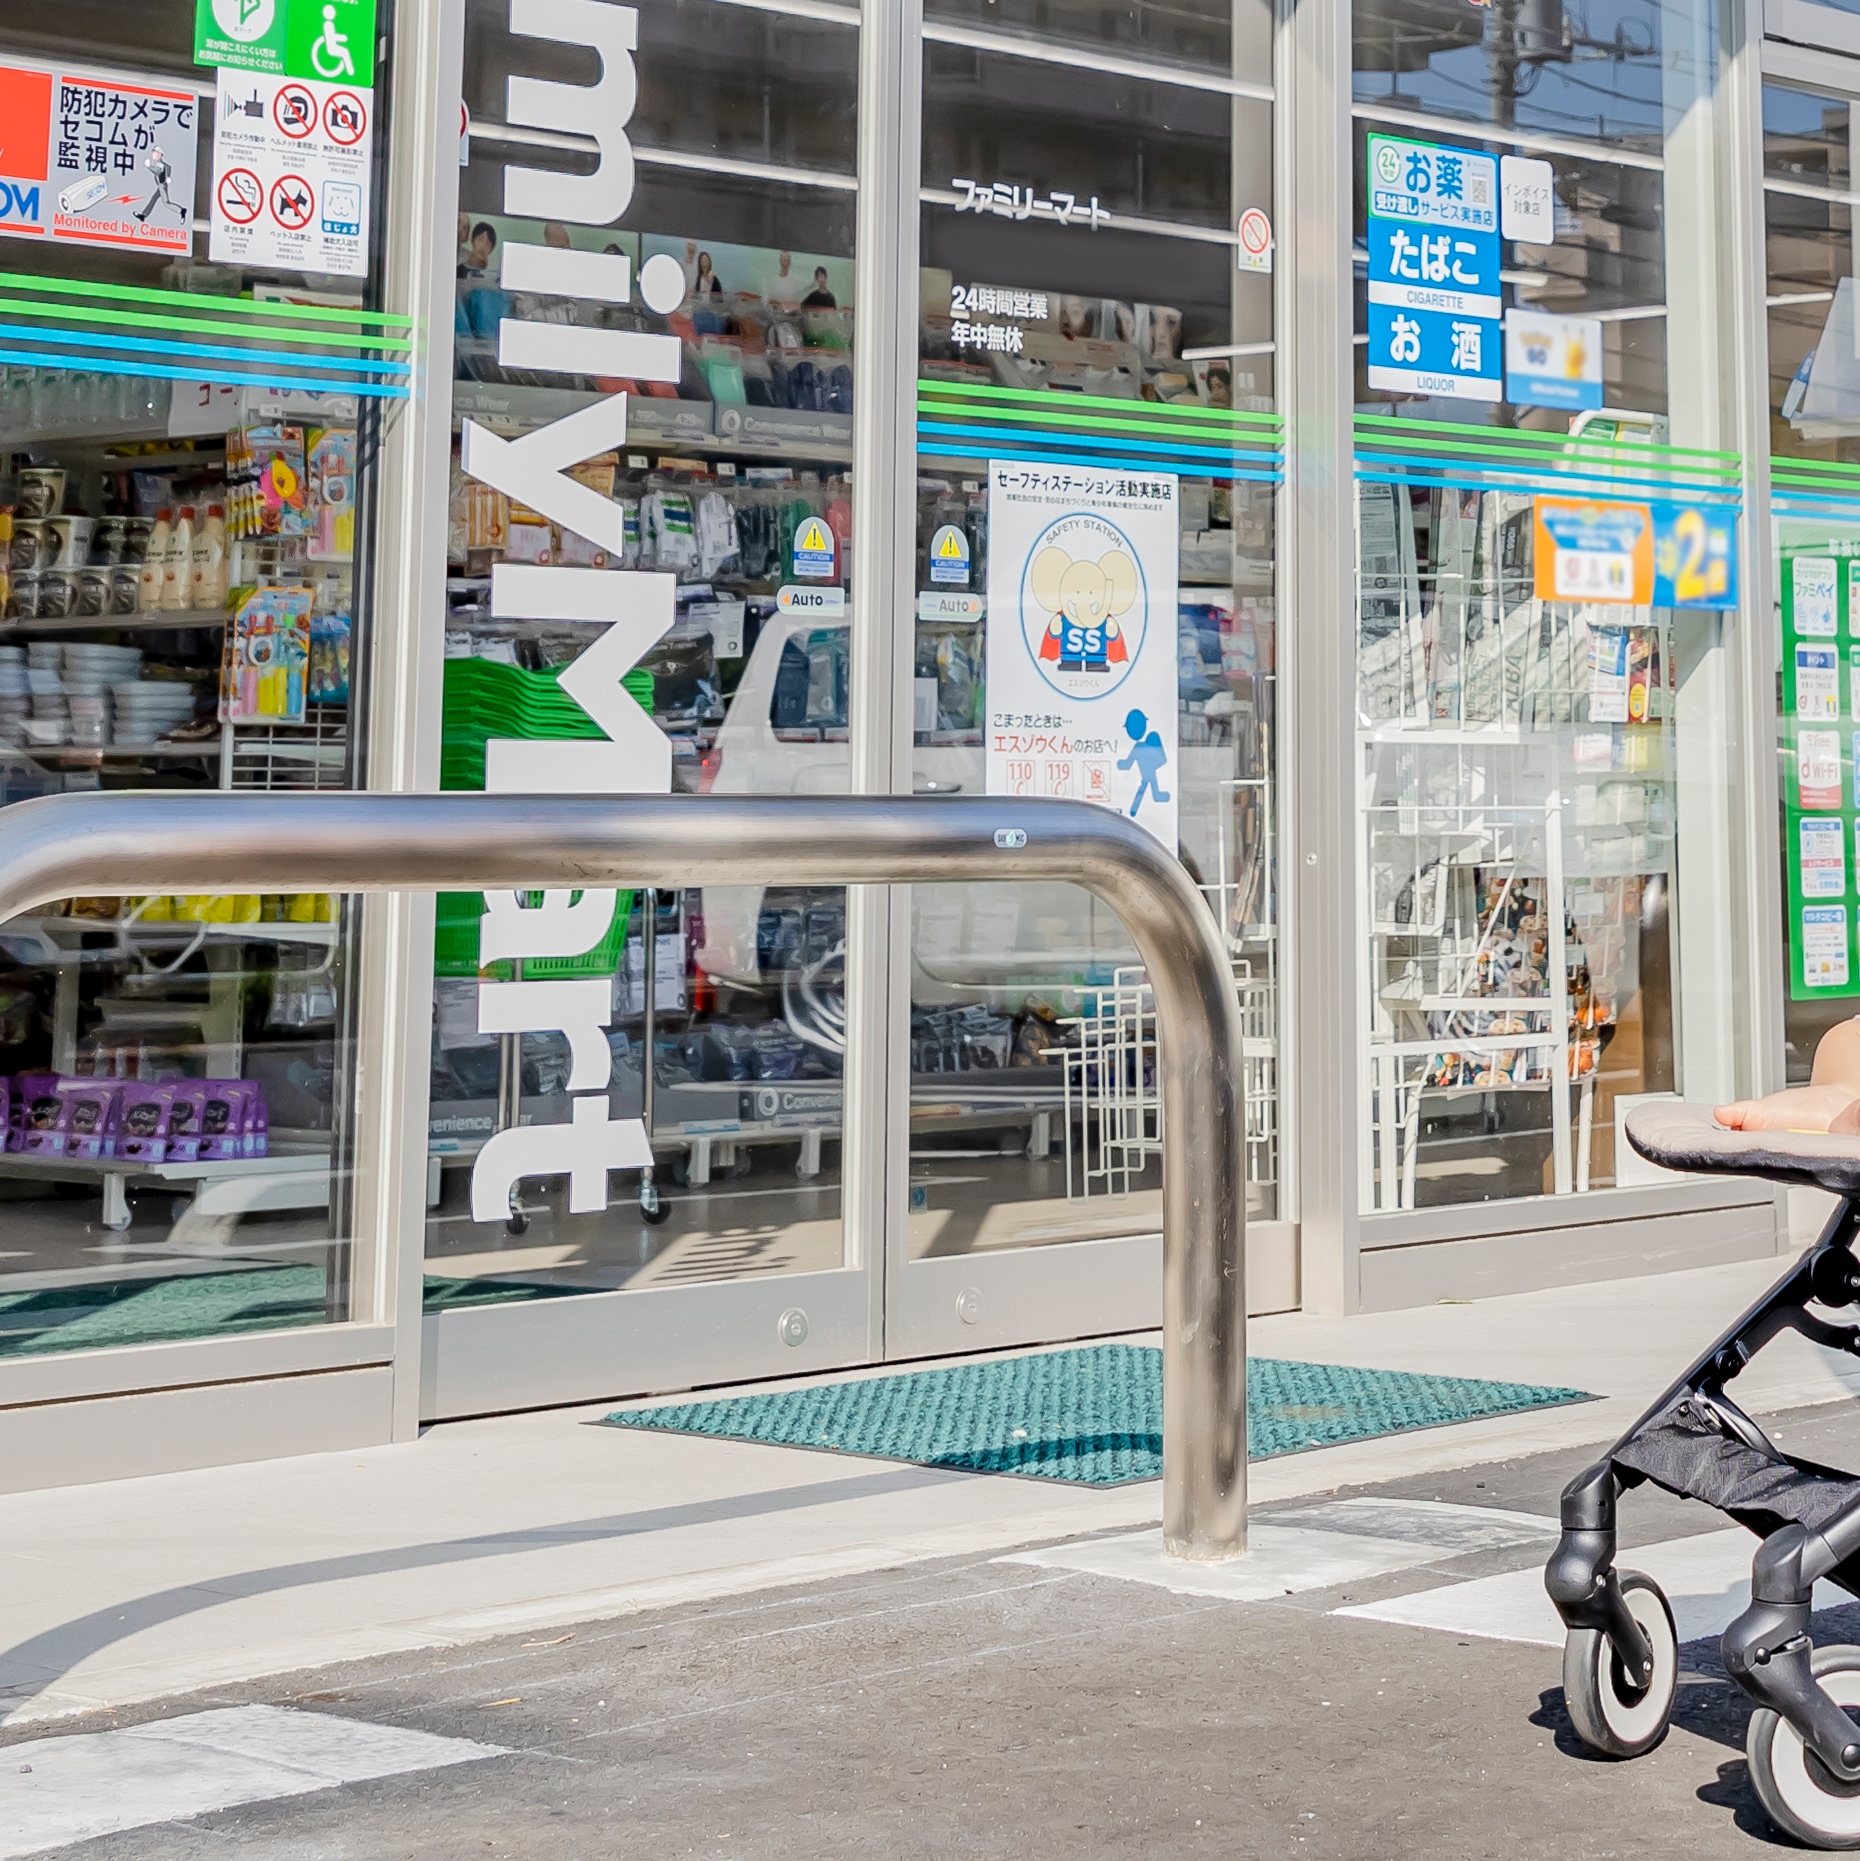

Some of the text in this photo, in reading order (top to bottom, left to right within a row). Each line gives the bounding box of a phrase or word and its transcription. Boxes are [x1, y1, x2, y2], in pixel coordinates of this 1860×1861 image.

[60, 85, 194, 130] 防犯カメラで
[59, 114, 156, 150] セコムが
[57, 141, 135, 177] 監視中
[1381, 152, 1396, 169] 24
[1405, 151, 1464, 201] お薬
[1504, 182, 1550, 200] インボイス
[951, 178, 1111, 231] ファミリーマート
[1421, 201, 1493, 227] サービス実施店
[1513, 199, 1541, 216] 対象店
[54, 213, 188, 241] Monitored by Camera
[1389, 229, 1480, 285] たばこ
[951, 284, 1048, 320] 24時間営業
[1406, 290, 1464, 310] CIGARETTE
[950, 320, 1024, 354] 年中無休
[1389, 313, 1482, 372] お酒
[1417, 376, 1455, 392] LIQUOR
[997, 470, 1172, 501] セーフティステーション活動実施店
[1046, 519, 1123, 548] SAFETY STATION
[798, 552, 831, 561] CAUTION
[935, 559, 966, 568] CAUTION
[791, 593, 824, 607] Auto
[1795, 582, 1834, 598] ファミペイ
[939, 599, 969, 613] Auto
[1066, 628, 1102, 653] SS
[1009, 763, 1032, 781] 110
[1048, 763, 1070, 781] 119
[1813, 763, 1838, 779] Wi-Fi
